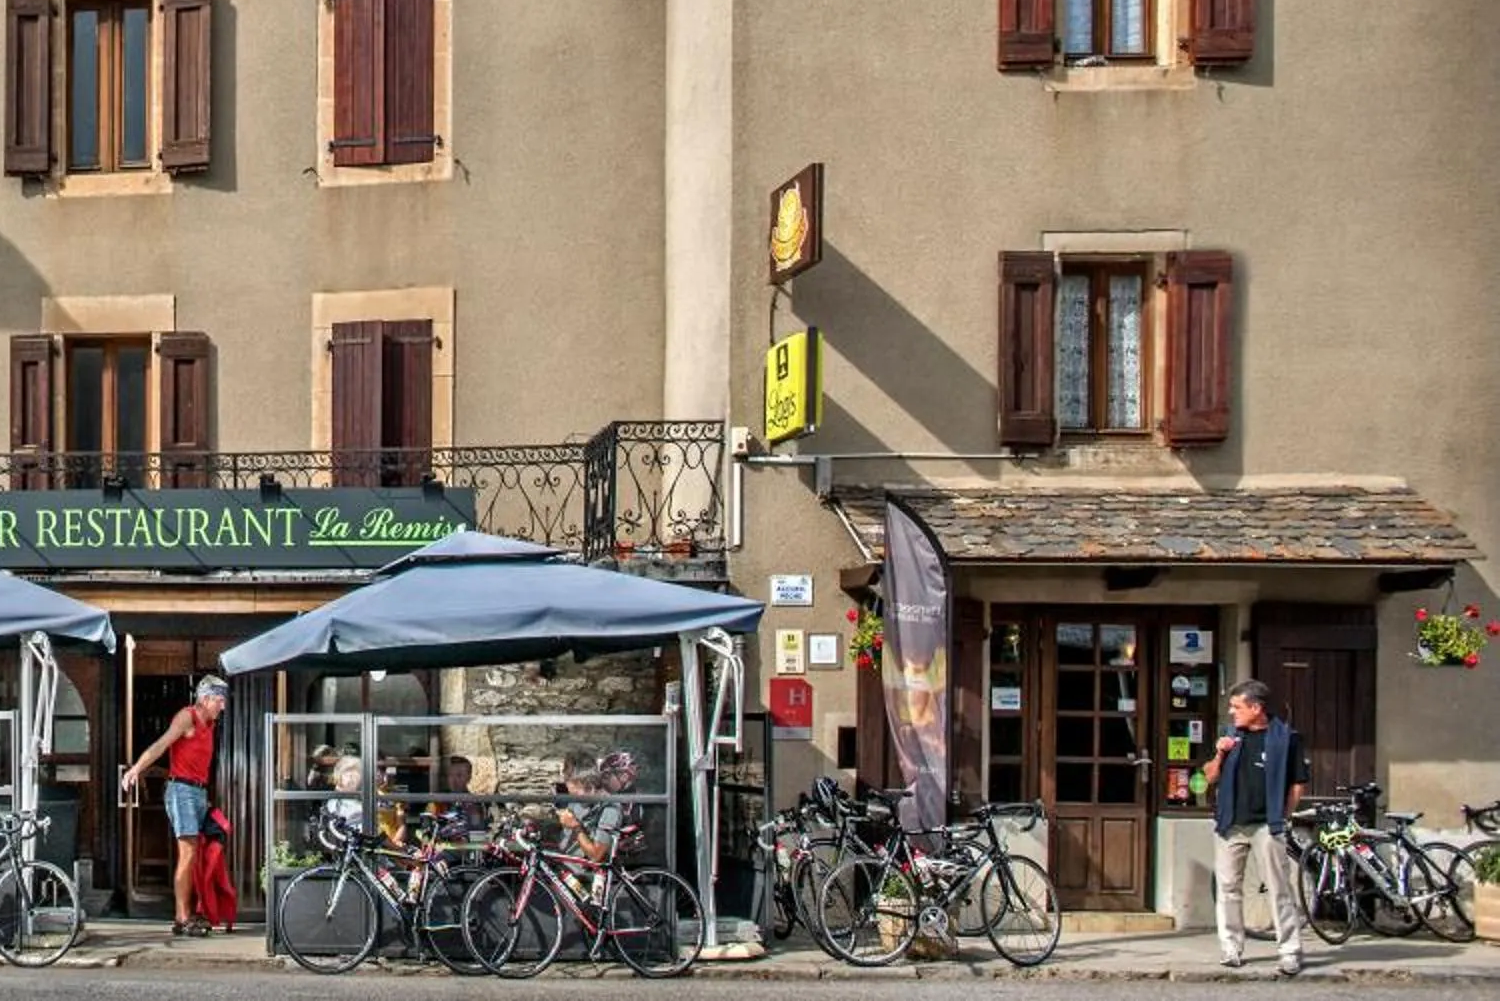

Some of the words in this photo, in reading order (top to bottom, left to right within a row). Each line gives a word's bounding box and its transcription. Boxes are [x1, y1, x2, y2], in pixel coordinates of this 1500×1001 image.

[35, 508, 302, 548] RESTAURANT
[309, 506, 351, 539] La
[788, 688, 806, 706] H
